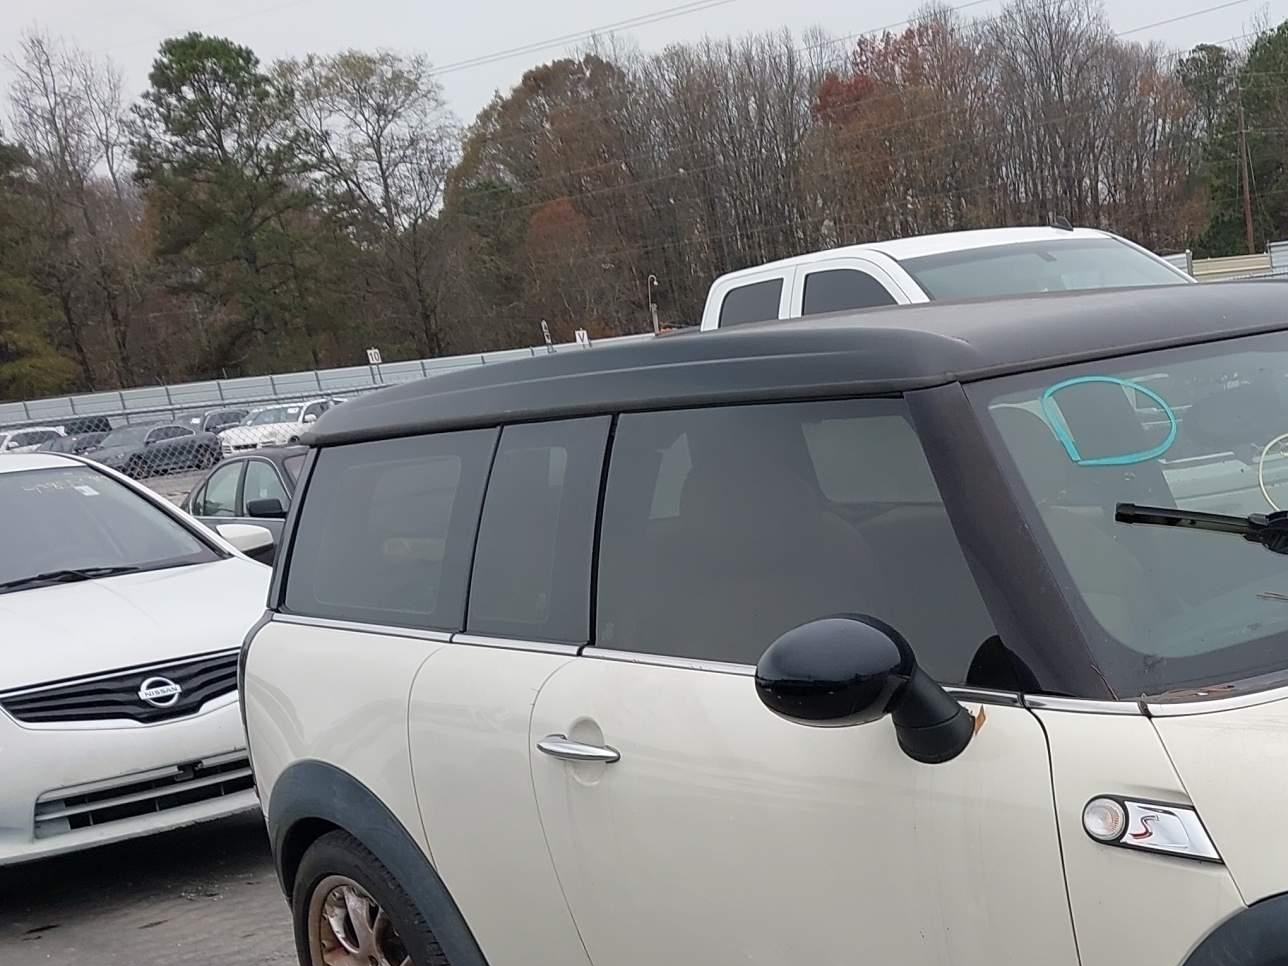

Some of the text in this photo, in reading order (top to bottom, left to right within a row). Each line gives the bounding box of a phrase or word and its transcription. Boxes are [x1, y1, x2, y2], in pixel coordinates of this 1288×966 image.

[369, 351, 380, 362] 10
[144, 686, 178, 697] NISSAN
[1128, 814, 1160, 840] S
